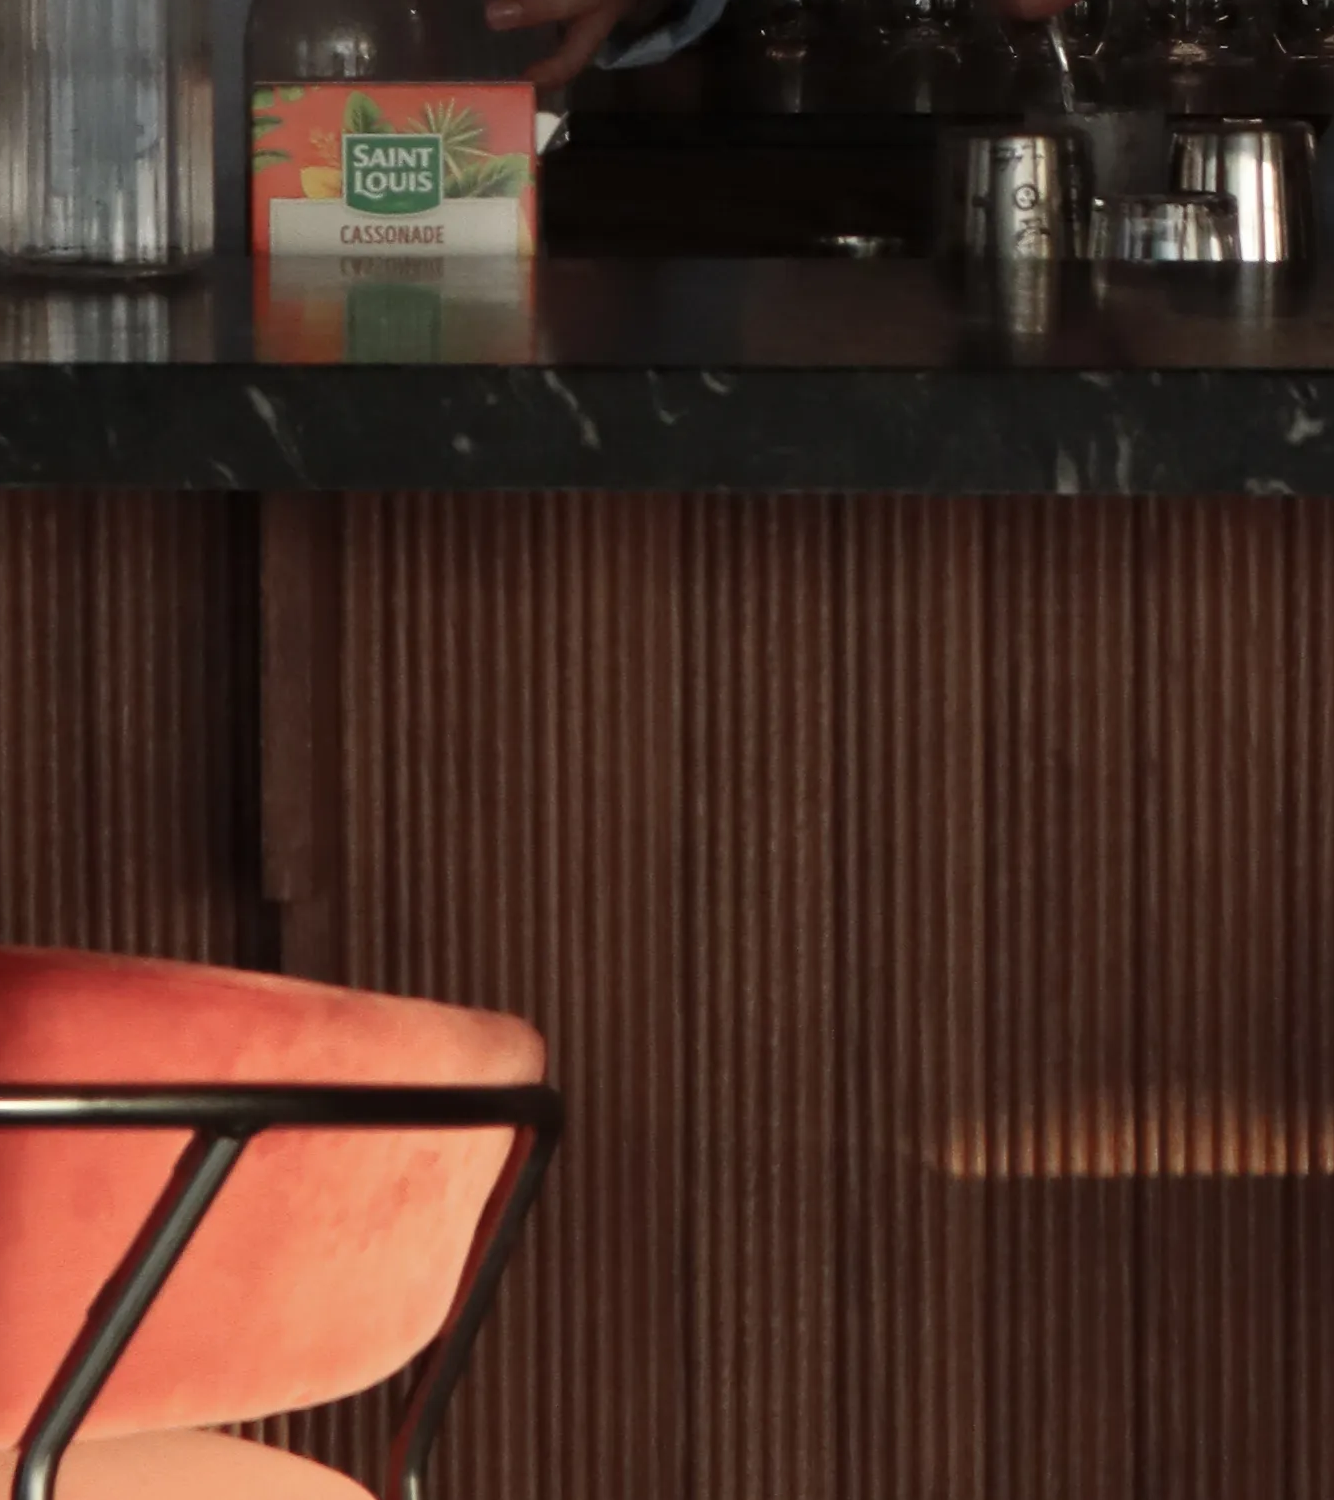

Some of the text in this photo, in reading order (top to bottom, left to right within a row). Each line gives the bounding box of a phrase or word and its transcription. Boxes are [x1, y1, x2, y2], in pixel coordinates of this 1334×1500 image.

[354, 144, 433, 167] SAINT
[355, 171, 433, 198] LOUIS
[341, 225, 444, 244] CASSONADE
